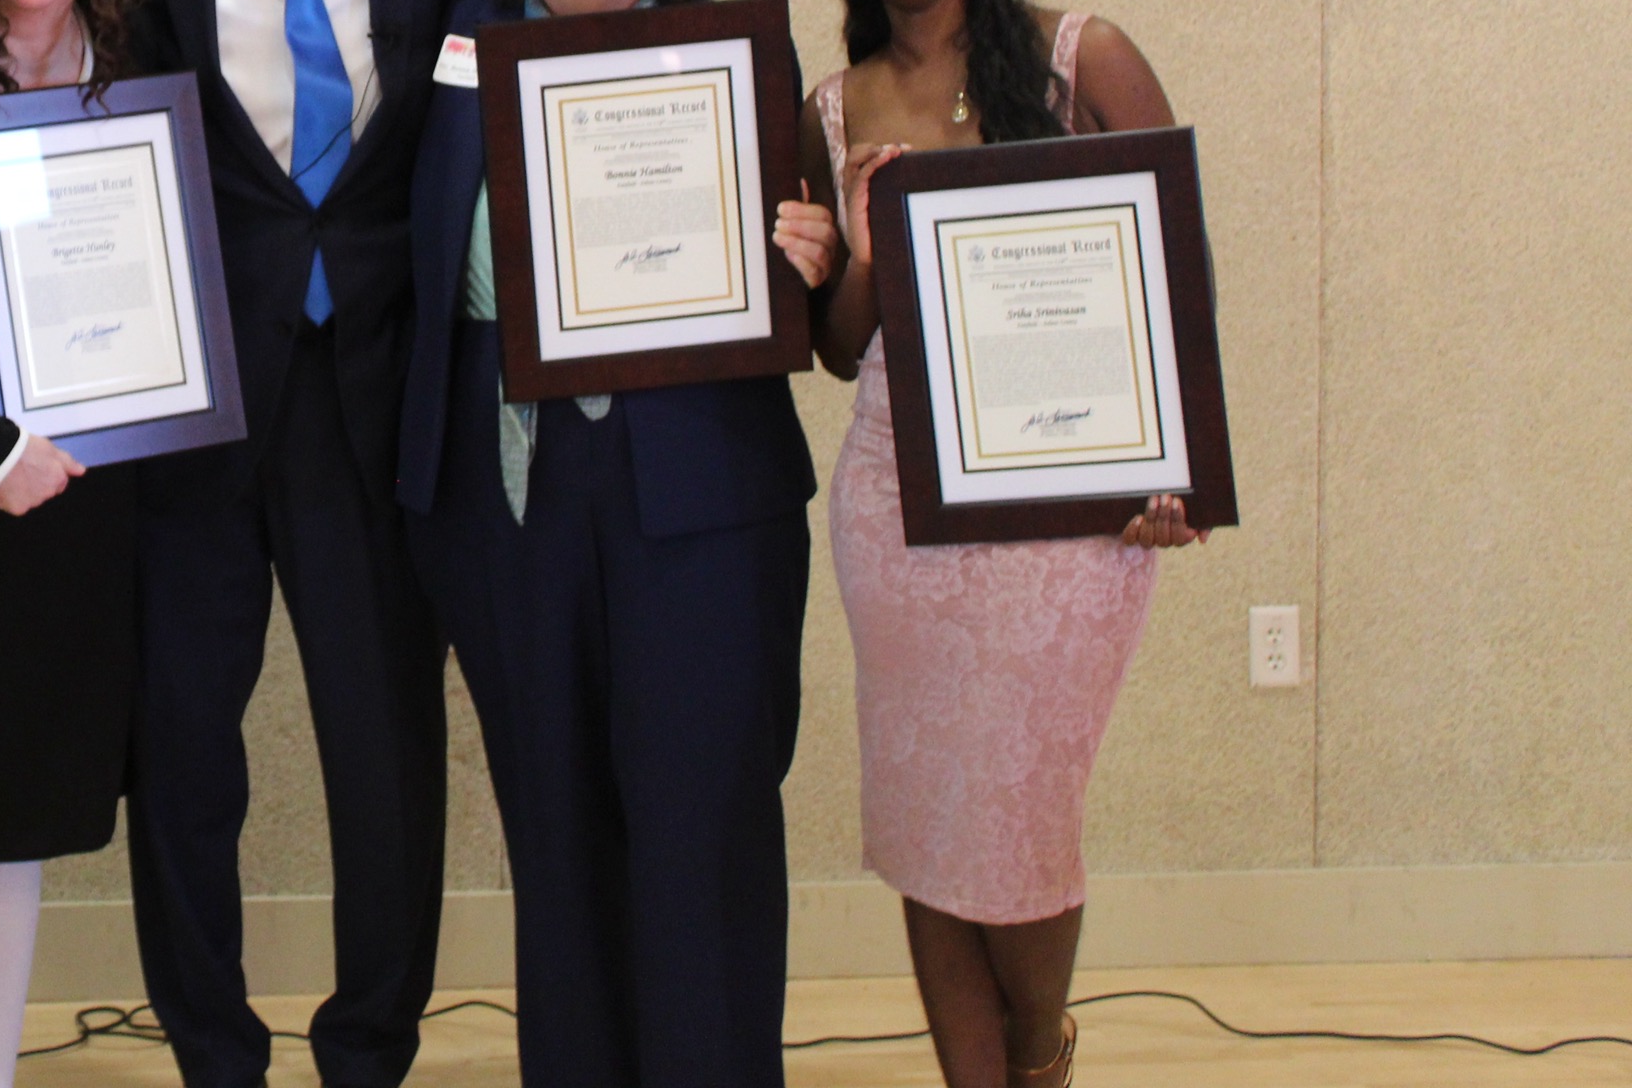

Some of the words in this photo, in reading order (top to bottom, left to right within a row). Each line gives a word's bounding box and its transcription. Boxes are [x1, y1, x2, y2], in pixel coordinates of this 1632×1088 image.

[595, 105, 665, 122] Congressional
[670, 100, 706, 115] Record
[101, 176, 133, 191] Record
[992, 243, 1066, 260] Congressional
[1072, 239, 1111, 253] Record
